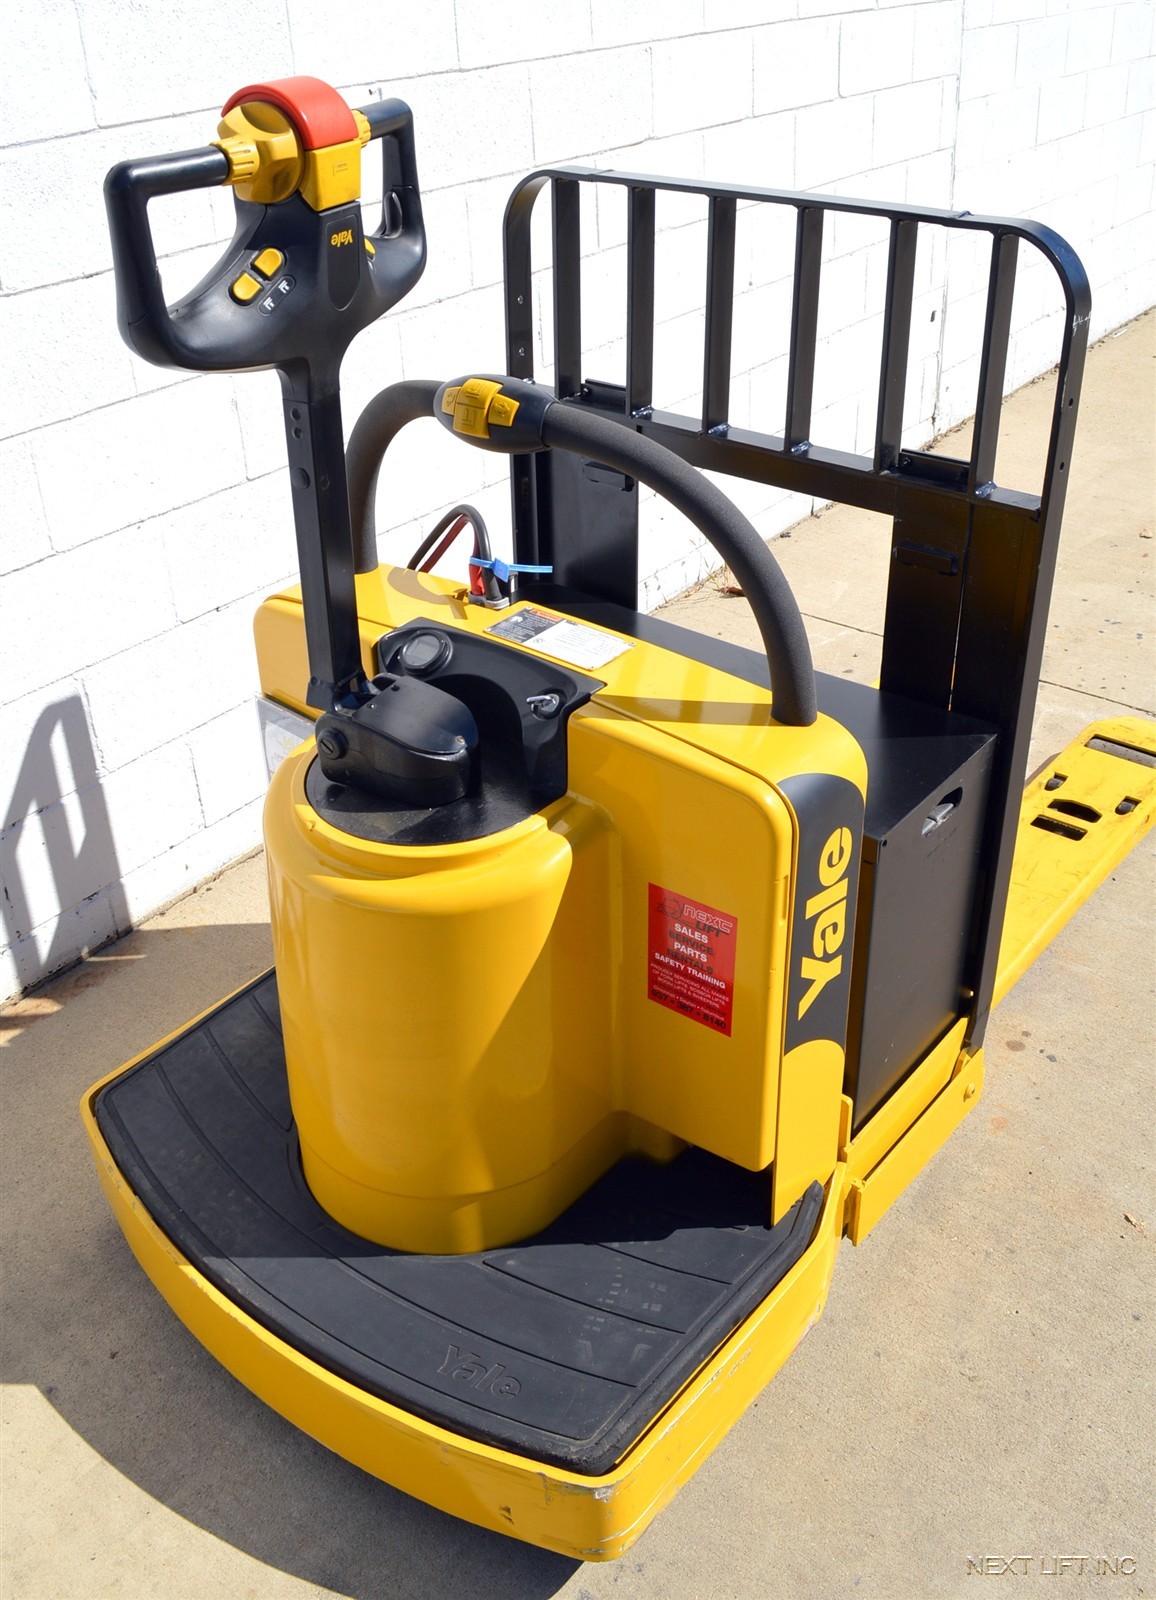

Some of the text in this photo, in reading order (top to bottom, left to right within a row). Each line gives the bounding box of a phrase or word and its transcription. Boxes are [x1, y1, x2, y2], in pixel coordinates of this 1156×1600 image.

[330, 229, 354, 247] Yale
[675, 923, 708, 945] SALES
[797, 826, 853, 1021] Yale
[669, 930, 713, 956] SERVICE
[674, 941, 707, 963] PARTS
[655, 952, 685, 971] SAFETY
[687, 967, 726, 990] TRAINING
[667, 948, 714, 976] RENTALS
[436, 1344, 523, 1399] Yale
